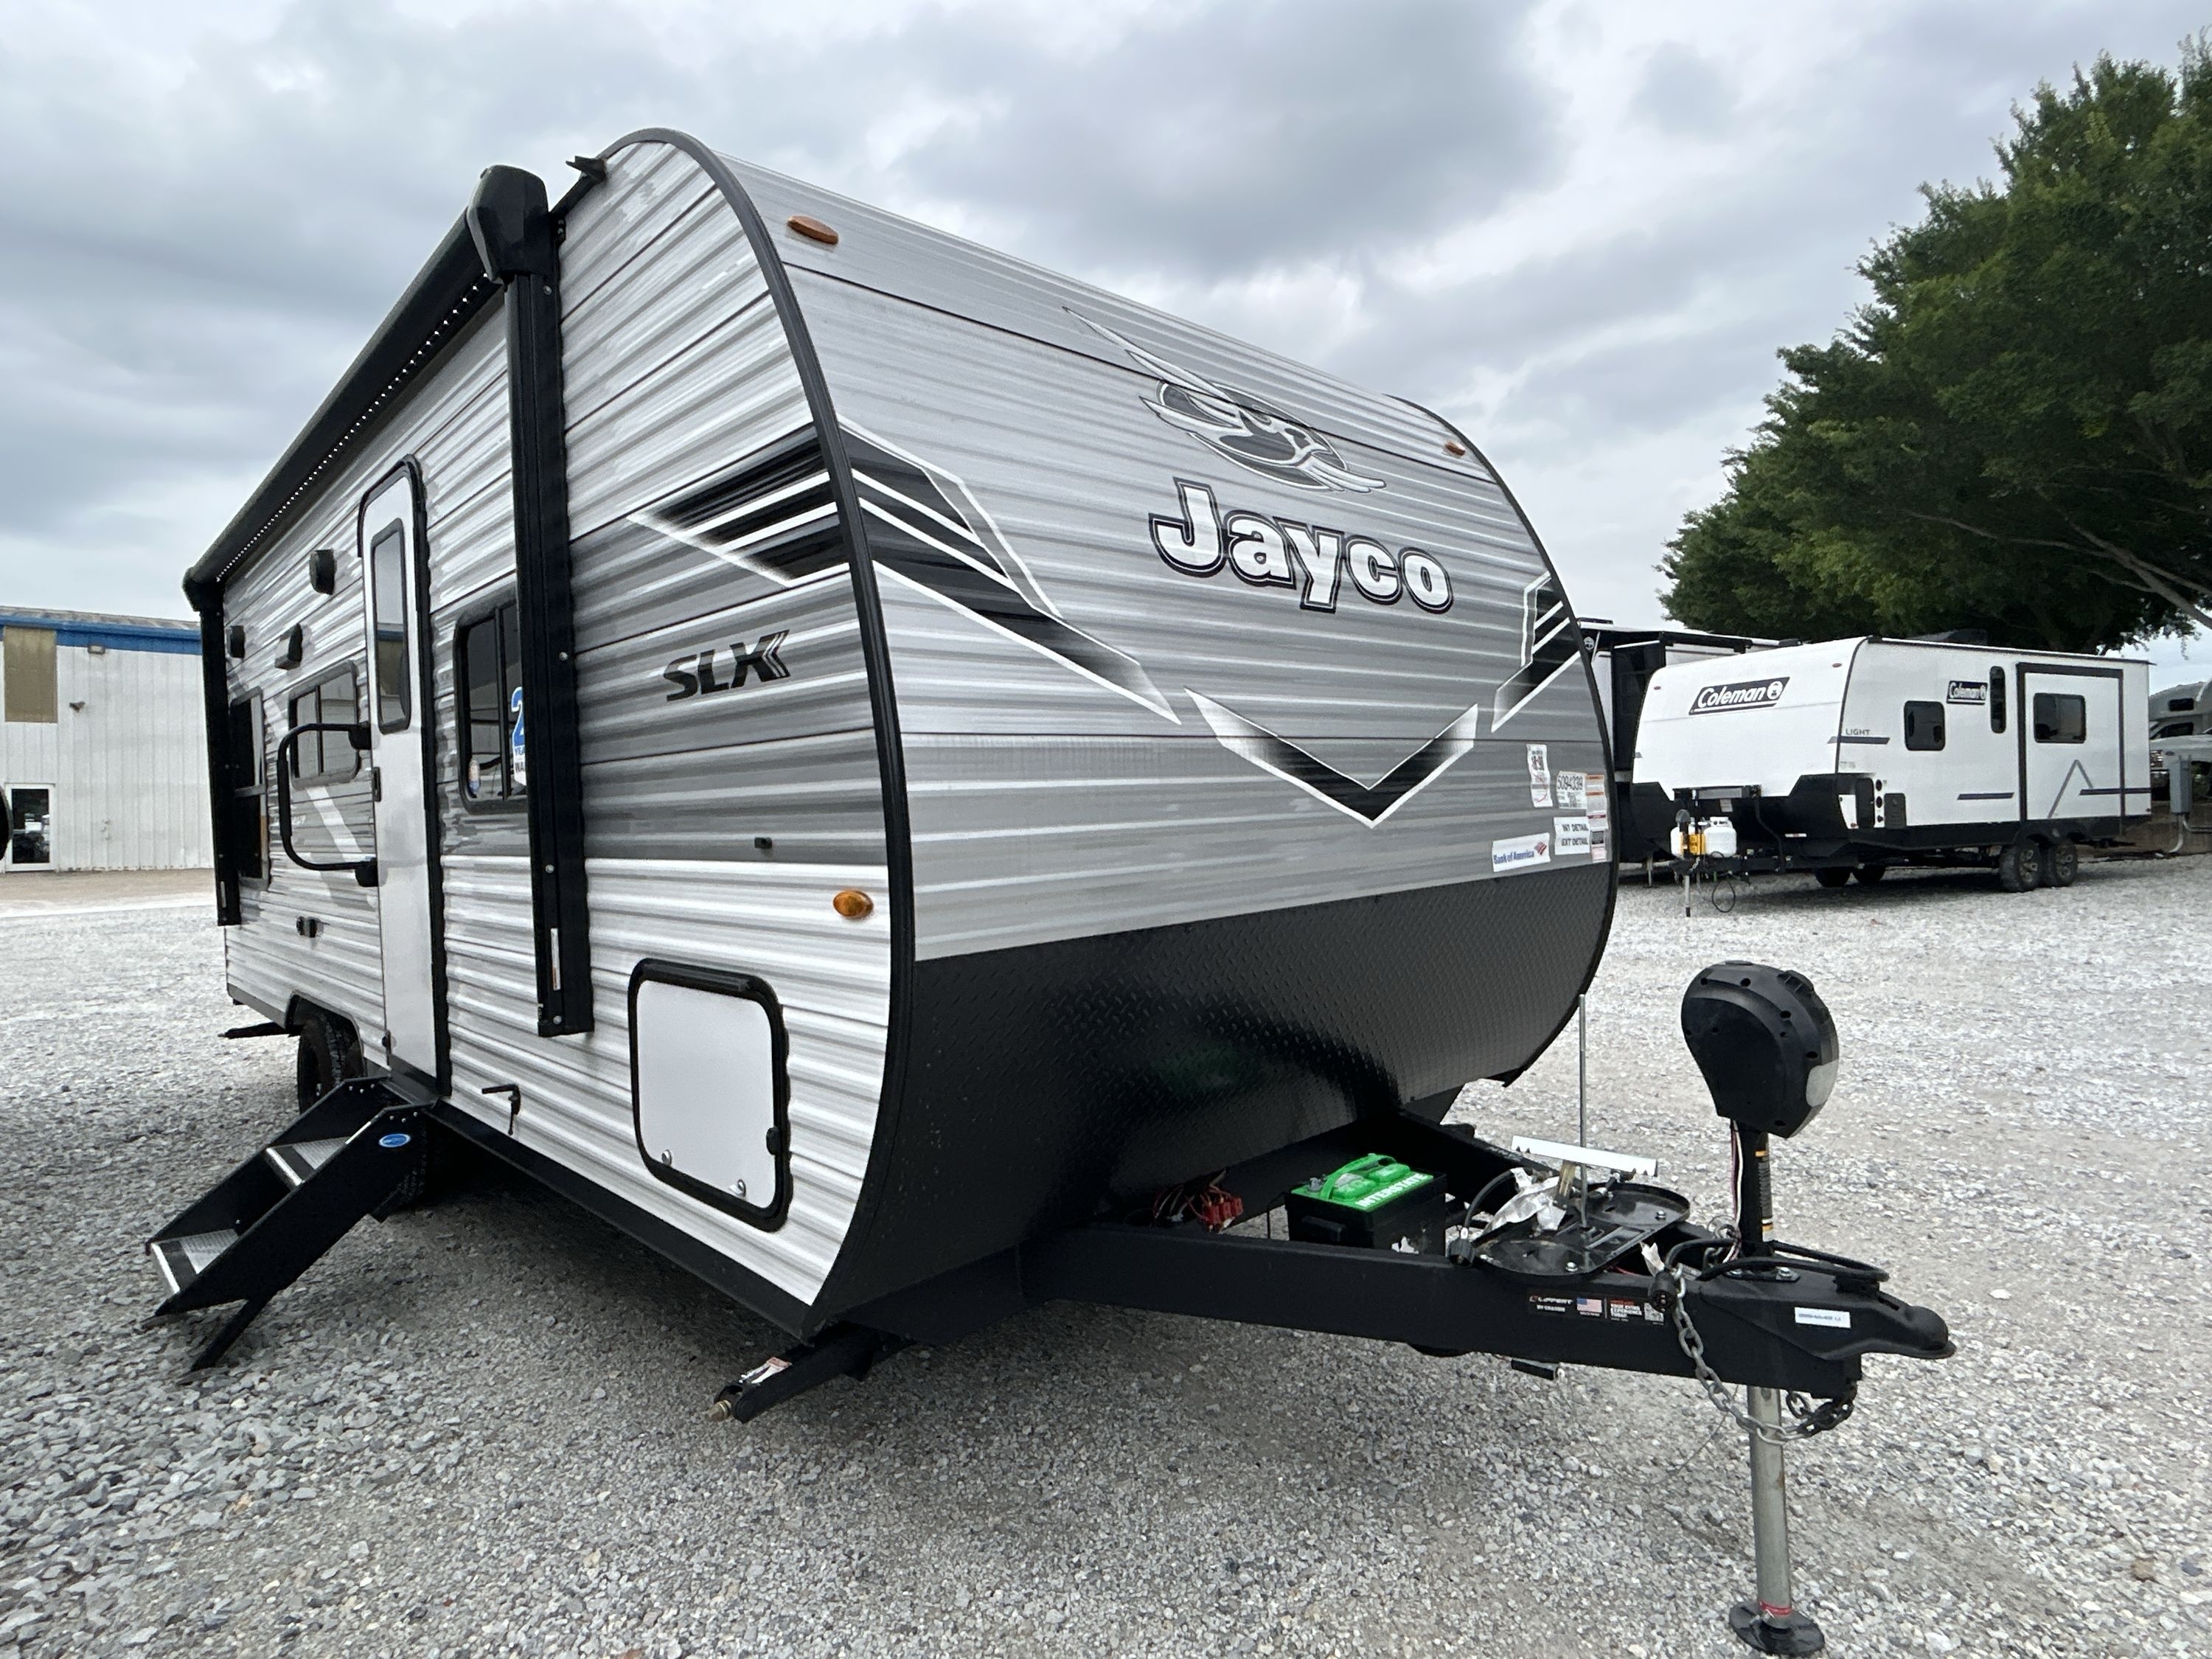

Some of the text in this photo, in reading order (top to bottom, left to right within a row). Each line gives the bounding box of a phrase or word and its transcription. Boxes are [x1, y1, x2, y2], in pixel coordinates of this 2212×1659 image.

[1149, 476, 1453, 613] Jayco
[664, 629, 791, 702] SLK
[1698, 686, 1766, 708] Coleman
[1950, 682, 1980, 699] Coleman
[1571, 824, 1589, 832] DETAIL
[1562, 838, 1588, 846] EXT DETAIL
[1494, 849, 1534, 864] Bank of America
[1355, 1173, 1428, 1207] INTERSTATE
